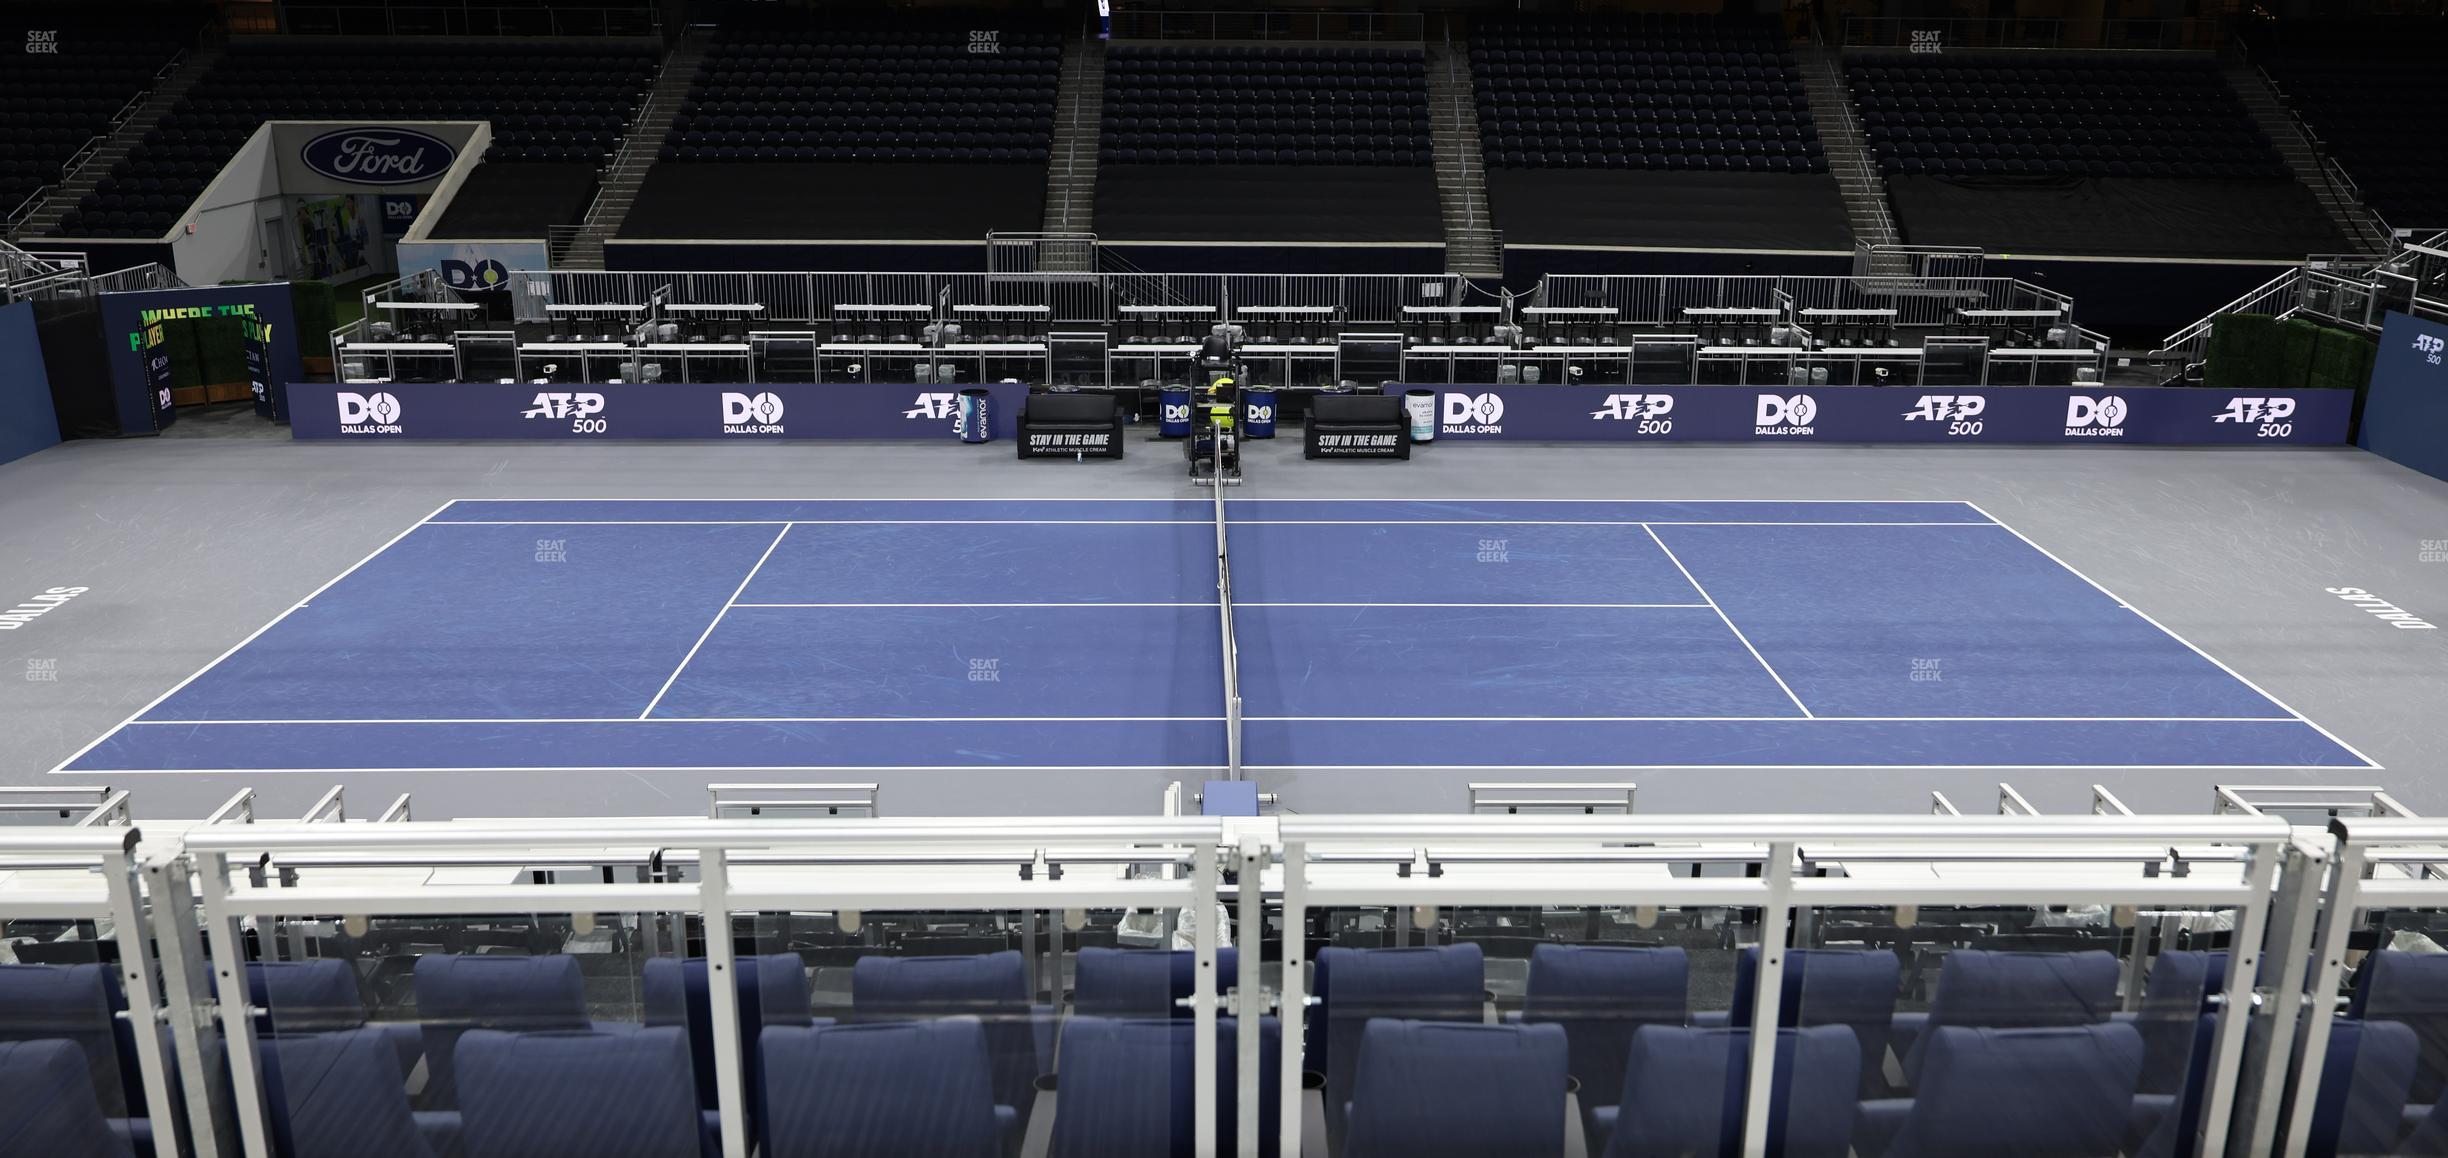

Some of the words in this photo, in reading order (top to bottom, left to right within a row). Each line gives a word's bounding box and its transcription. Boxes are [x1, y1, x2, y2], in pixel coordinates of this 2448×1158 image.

[333, 136, 425, 174] Ford
[2411, 334, 2444, 352] ATP
[2426, 354, 2441, 365] 500
[337, 392, 401, 424] DO
[520, 392, 605, 419] ATP
[722, 392, 784, 424] DO
[1165, 404, 1189, 418] DO
[1248, 404, 1272, 419] DO
[1443, 393, 1504, 424] DO
[1589, 394, 1674, 420] ATP
[1756, 394, 1817, 426] DO
[1901, 395, 1986, 421] ATP
[2065, 395, 2128, 427] DO
[2211, 397, 2296, 423] ATP
[572, 419, 607, 433] 500
[979, 398, 987, 439] evamor
[341, 425, 376, 434] DALLAS
[377, 425, 402, 434] OPEN
[724, 425, 757, 434] DALLAS
[758, 425, 784, 434] OPEN
[1443, 425, 1476, 434] DALLAS
[1477, 425, 1501, 434] OPEN
[1637, 420, 1672, 434] 500
[1755, 426, 1788, 435] DALLAS
[1789, 427, 1814, 435] OPEN
[1948, 421, 1983, 435] 500
[2065, 428, 2098, 436] DALLAS
[2098, 428, 2124, 436] OPEN
[2257, 423, 2292, 437] 500
[1030, 434, 1052, 446] STAY
[1052, 434, 1064, 446] IN
[1064, 434, 1082, 445] THE
[1082, 434, 1110, 445] GAME
[1318, 435, 1341, 446] STAY
[1341, 435, 1352, 446] IN
[1353, 435, 1370, 446] THE
[1370, 435, 1398, 446] GAME
[2325, 587, 2438, 629] DALLAS
